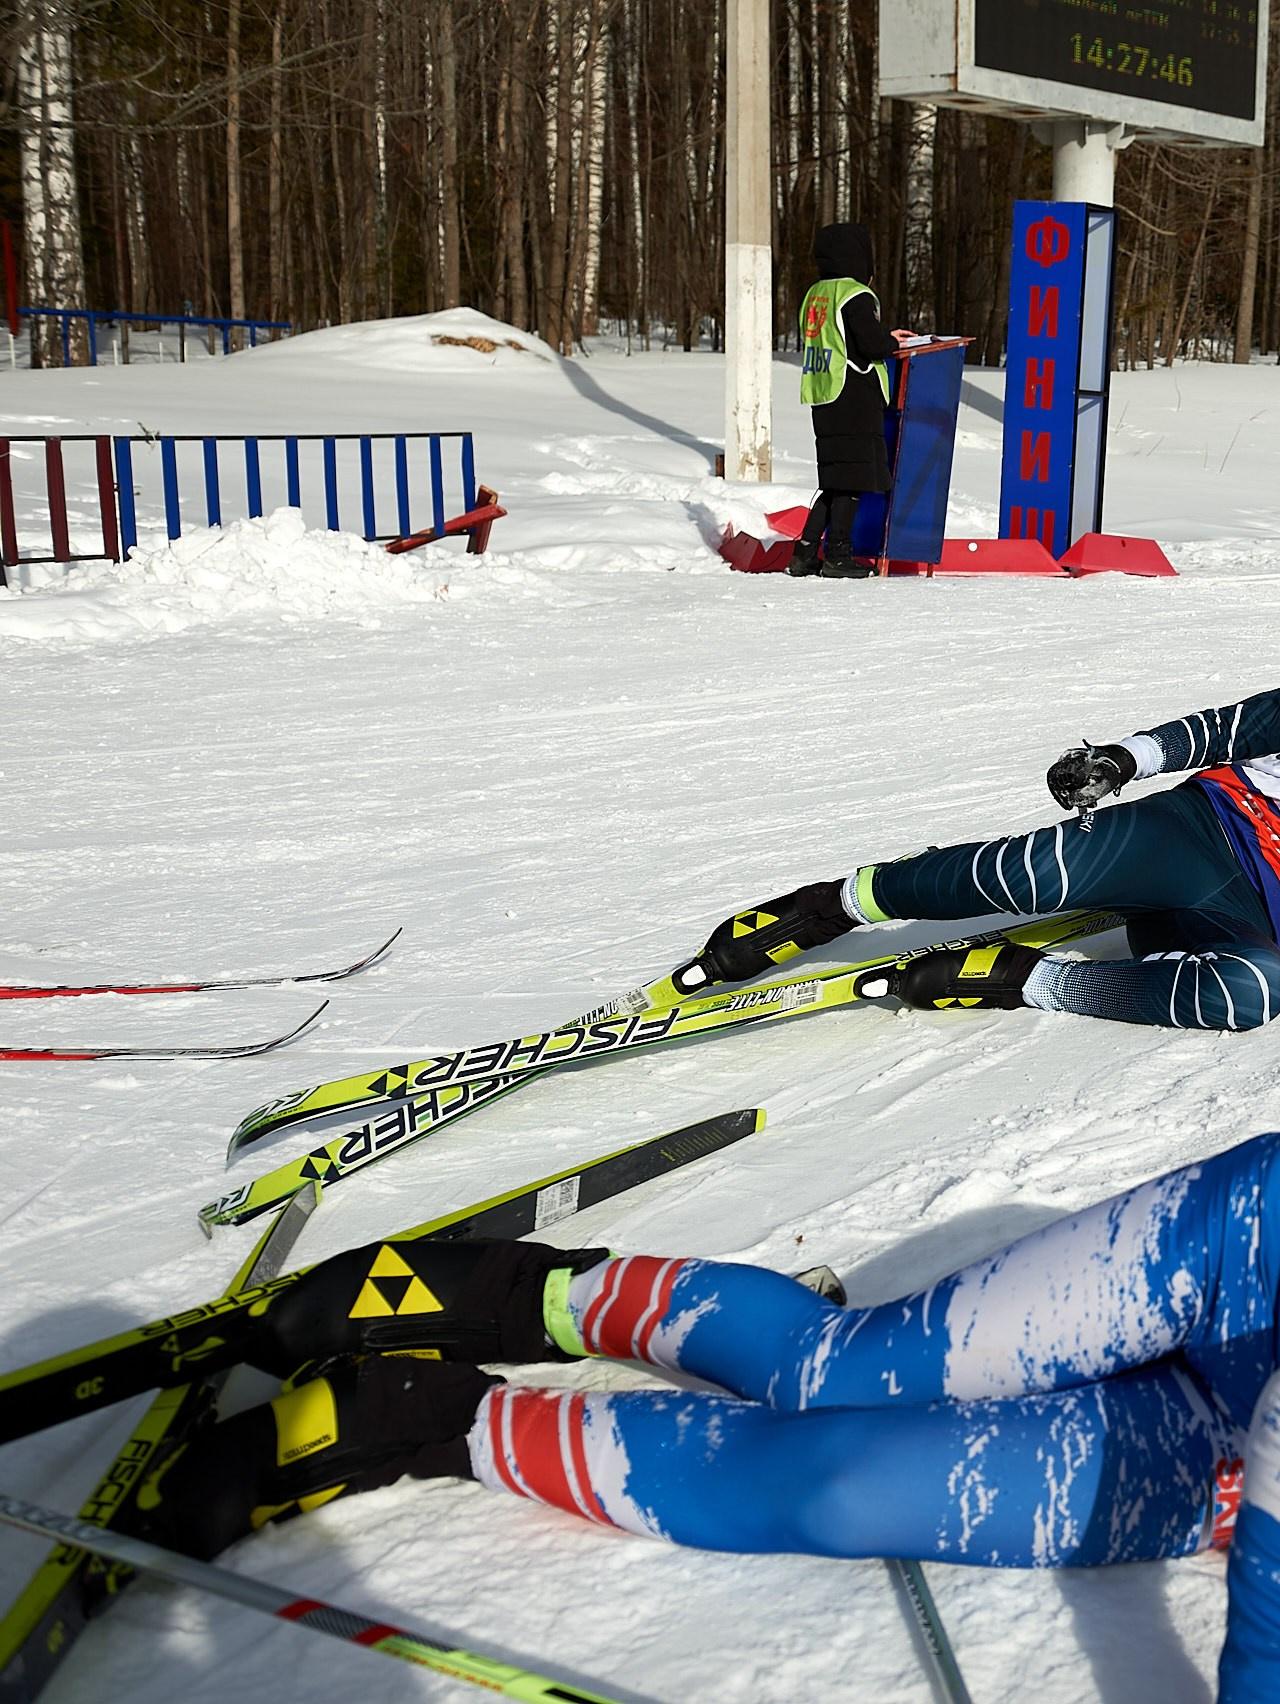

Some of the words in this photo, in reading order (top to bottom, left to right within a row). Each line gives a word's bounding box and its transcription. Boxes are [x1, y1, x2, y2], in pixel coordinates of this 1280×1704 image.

[1070, 32, 1194, 87] 14:27:46
[802, 346, 833, 375] ДЬЯ
[1009, 215, 1071, 558] ФИНИШ
[1078, 811, 1095, 833] SKI
[414, 1008, 681, 1087] FISCHER
[137, 1271, 303, 1337] ISCHER
[48, 1438, 154, 1566] FISCHR
